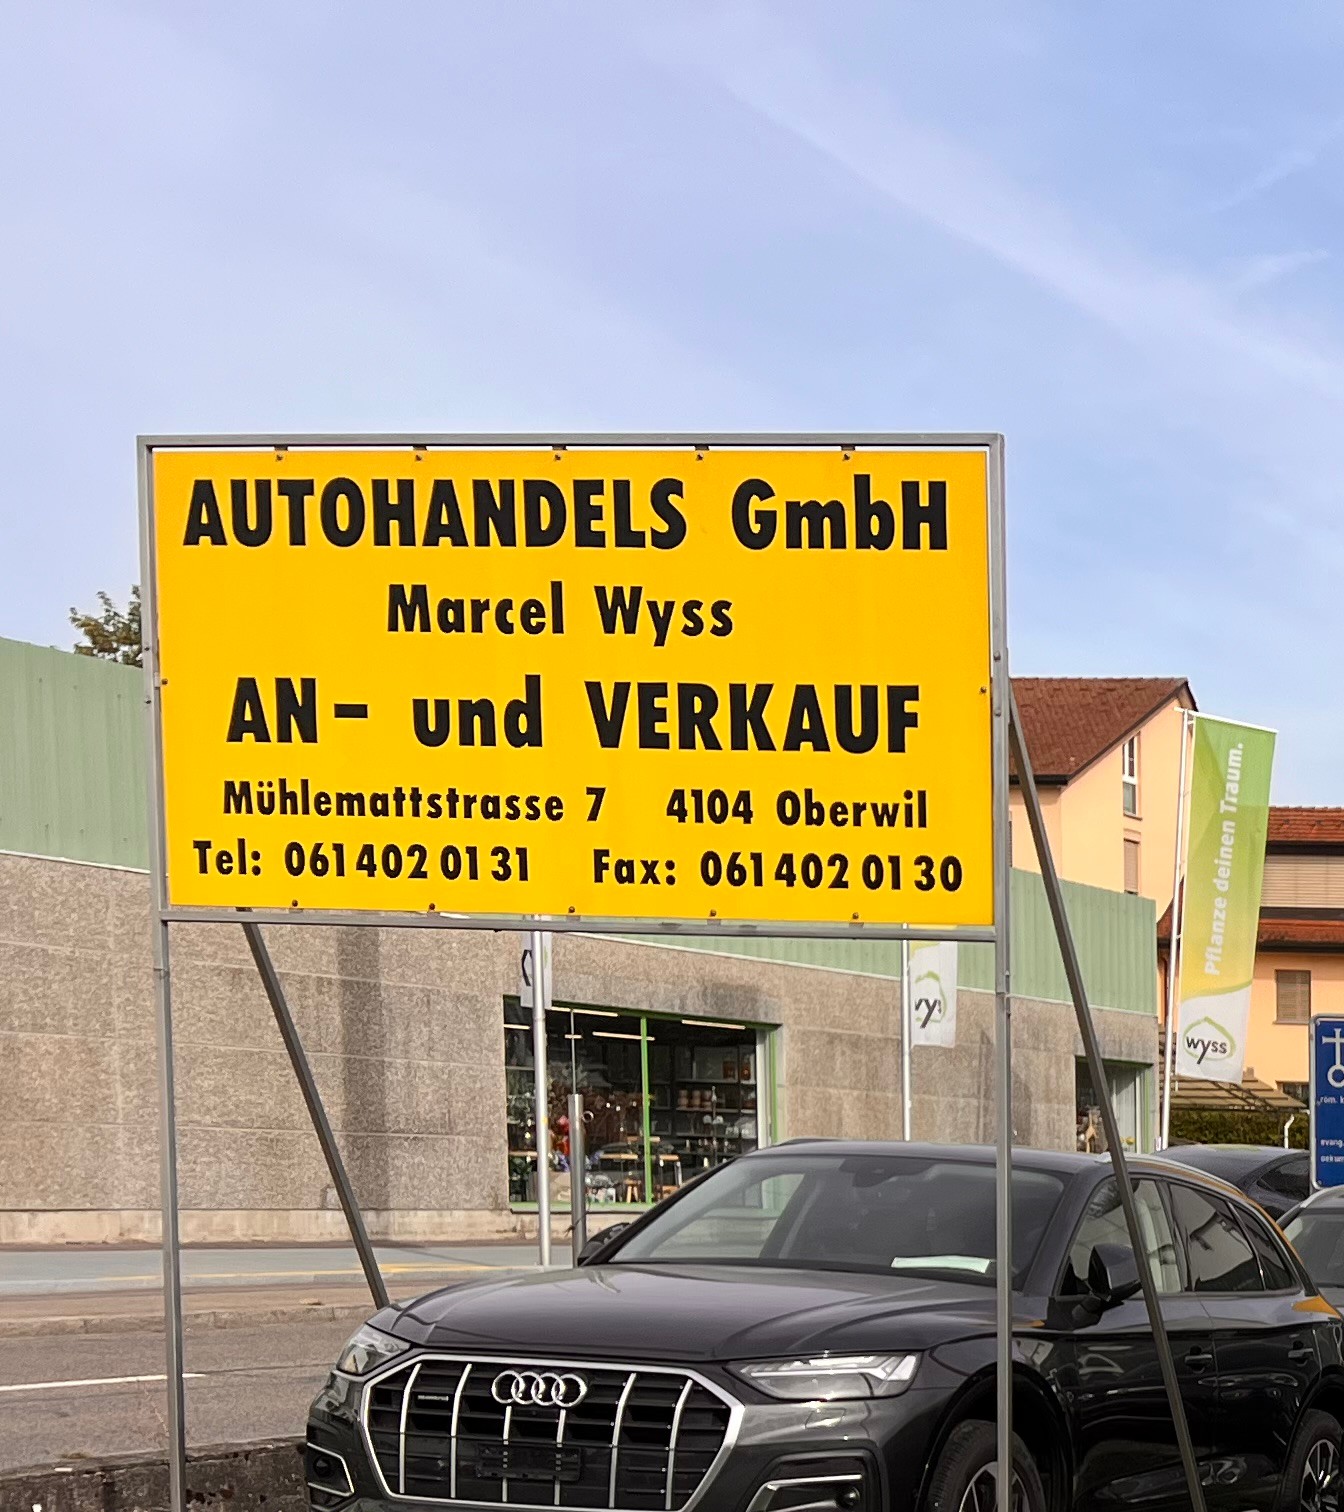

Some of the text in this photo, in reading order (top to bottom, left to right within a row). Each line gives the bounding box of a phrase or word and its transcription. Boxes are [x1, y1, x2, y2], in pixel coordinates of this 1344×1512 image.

[183, 473, 948, 552] AUTOHANDELS GmbH
[388, 580, 733, 648] Marcel Wyss
[412, 674, 543, 751] und
[584, 682, 920, 755] VERKAUF
[223, 778, 927, 829] Mühlemattstrasse 7 4104 Oberwil
[193, 837, 262, 876] Tel:
[593, 848, 677, 887] Fax:
[1204, 742, 1244, 976] Pflanze deinen Traum.
[1186, 1037, 1228, 1064] wyss
